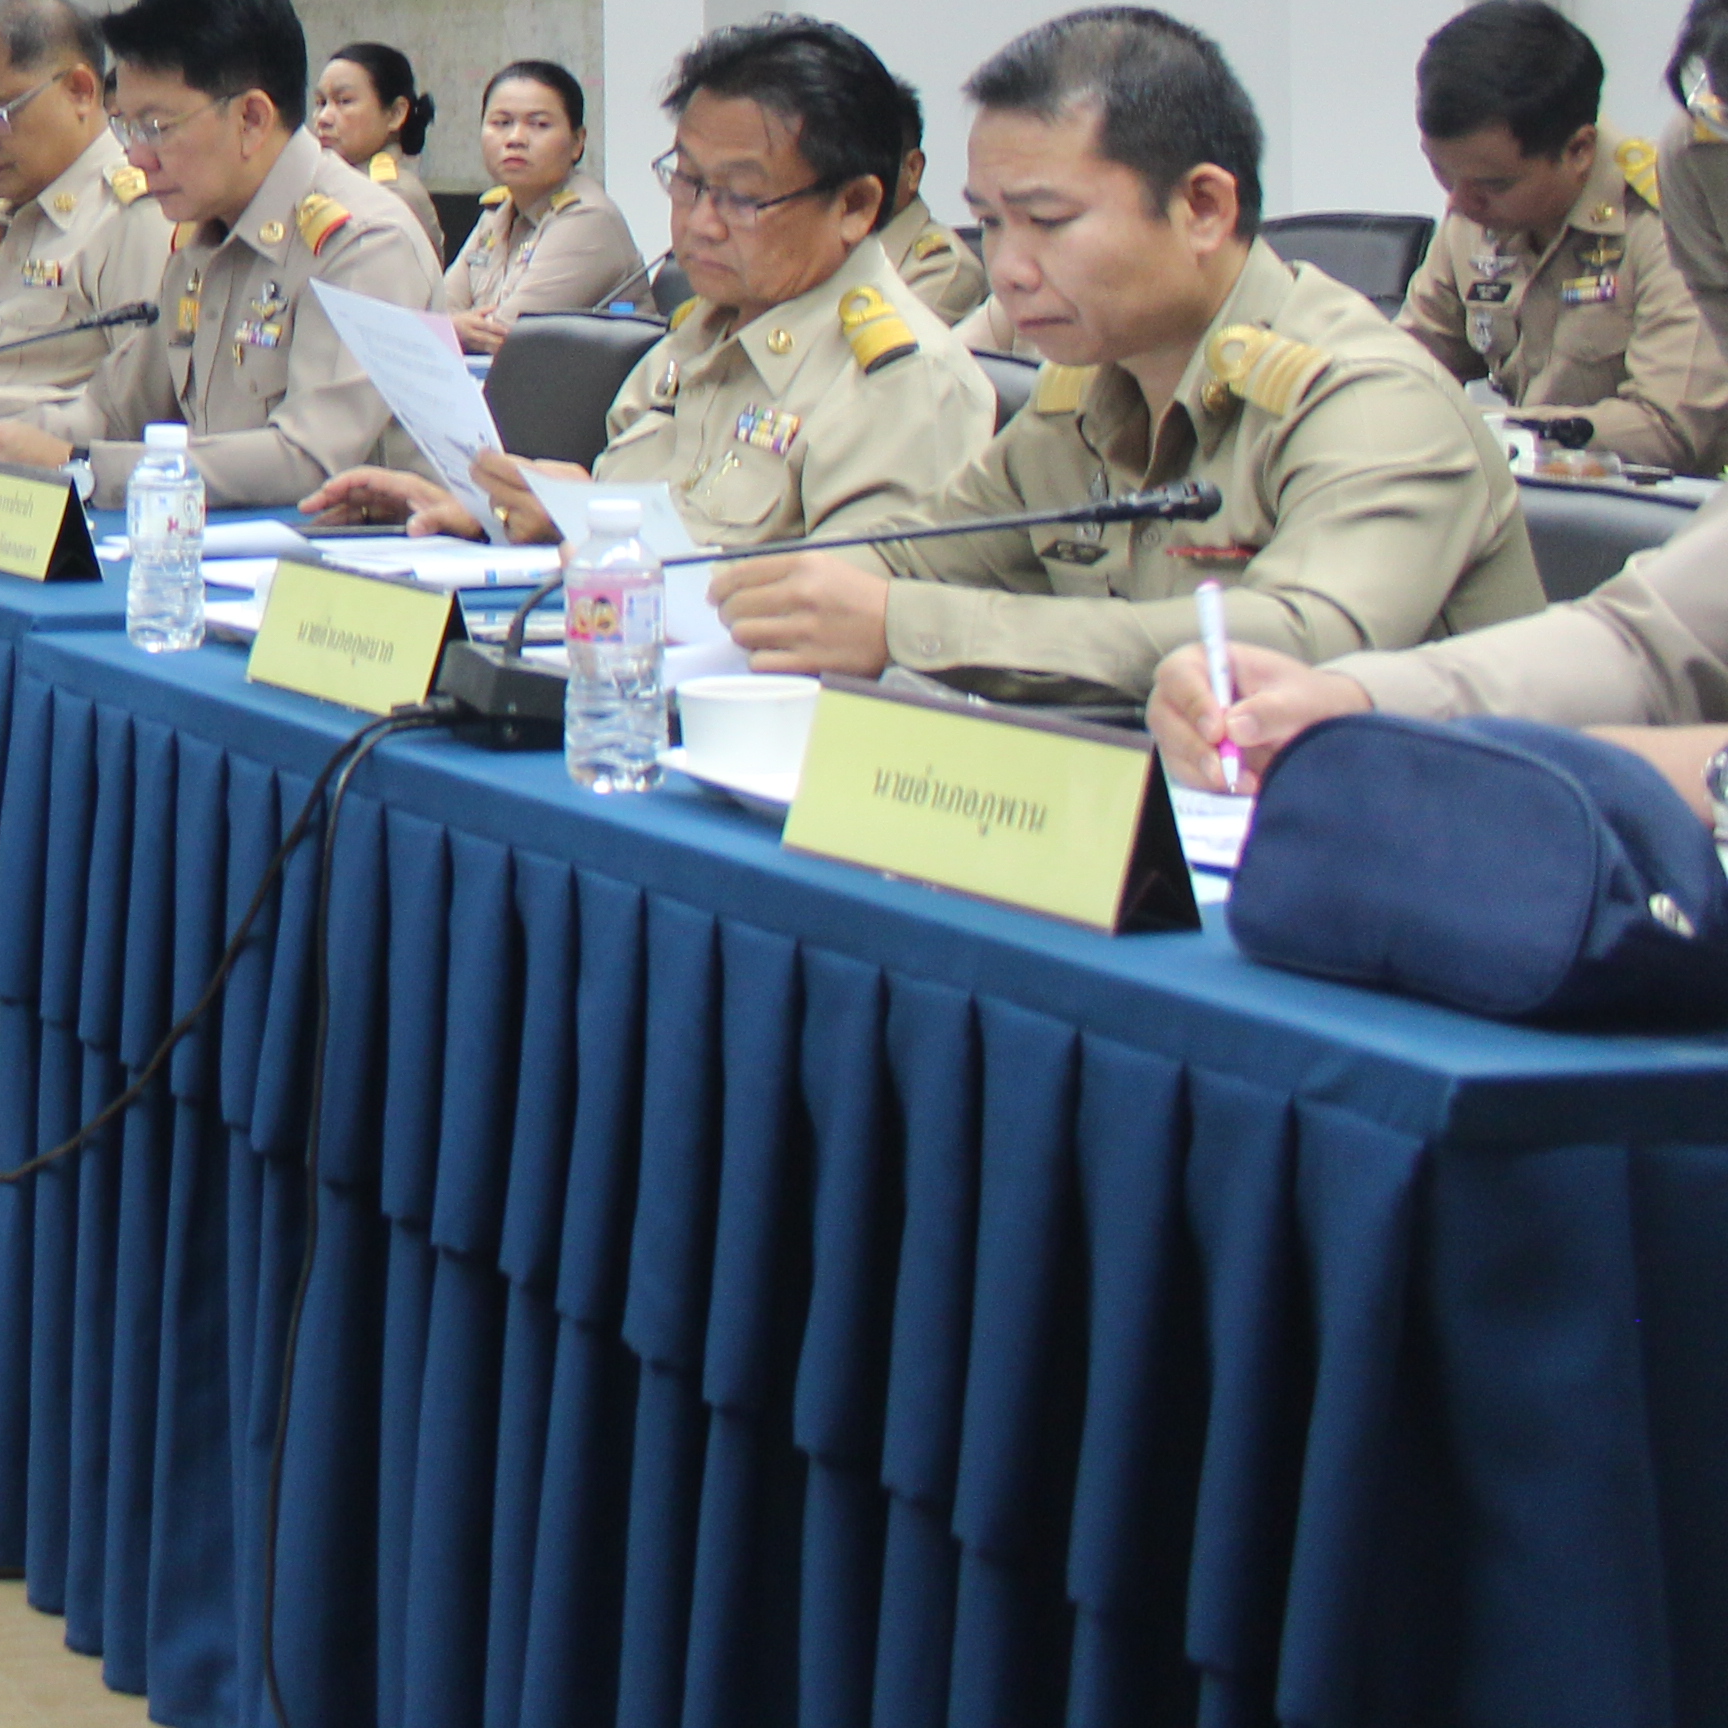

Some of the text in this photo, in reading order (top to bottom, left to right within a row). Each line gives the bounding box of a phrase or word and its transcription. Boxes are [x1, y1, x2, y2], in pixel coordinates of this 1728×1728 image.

[872, 763, 1048, 837] นายอำเภอภูพาน
